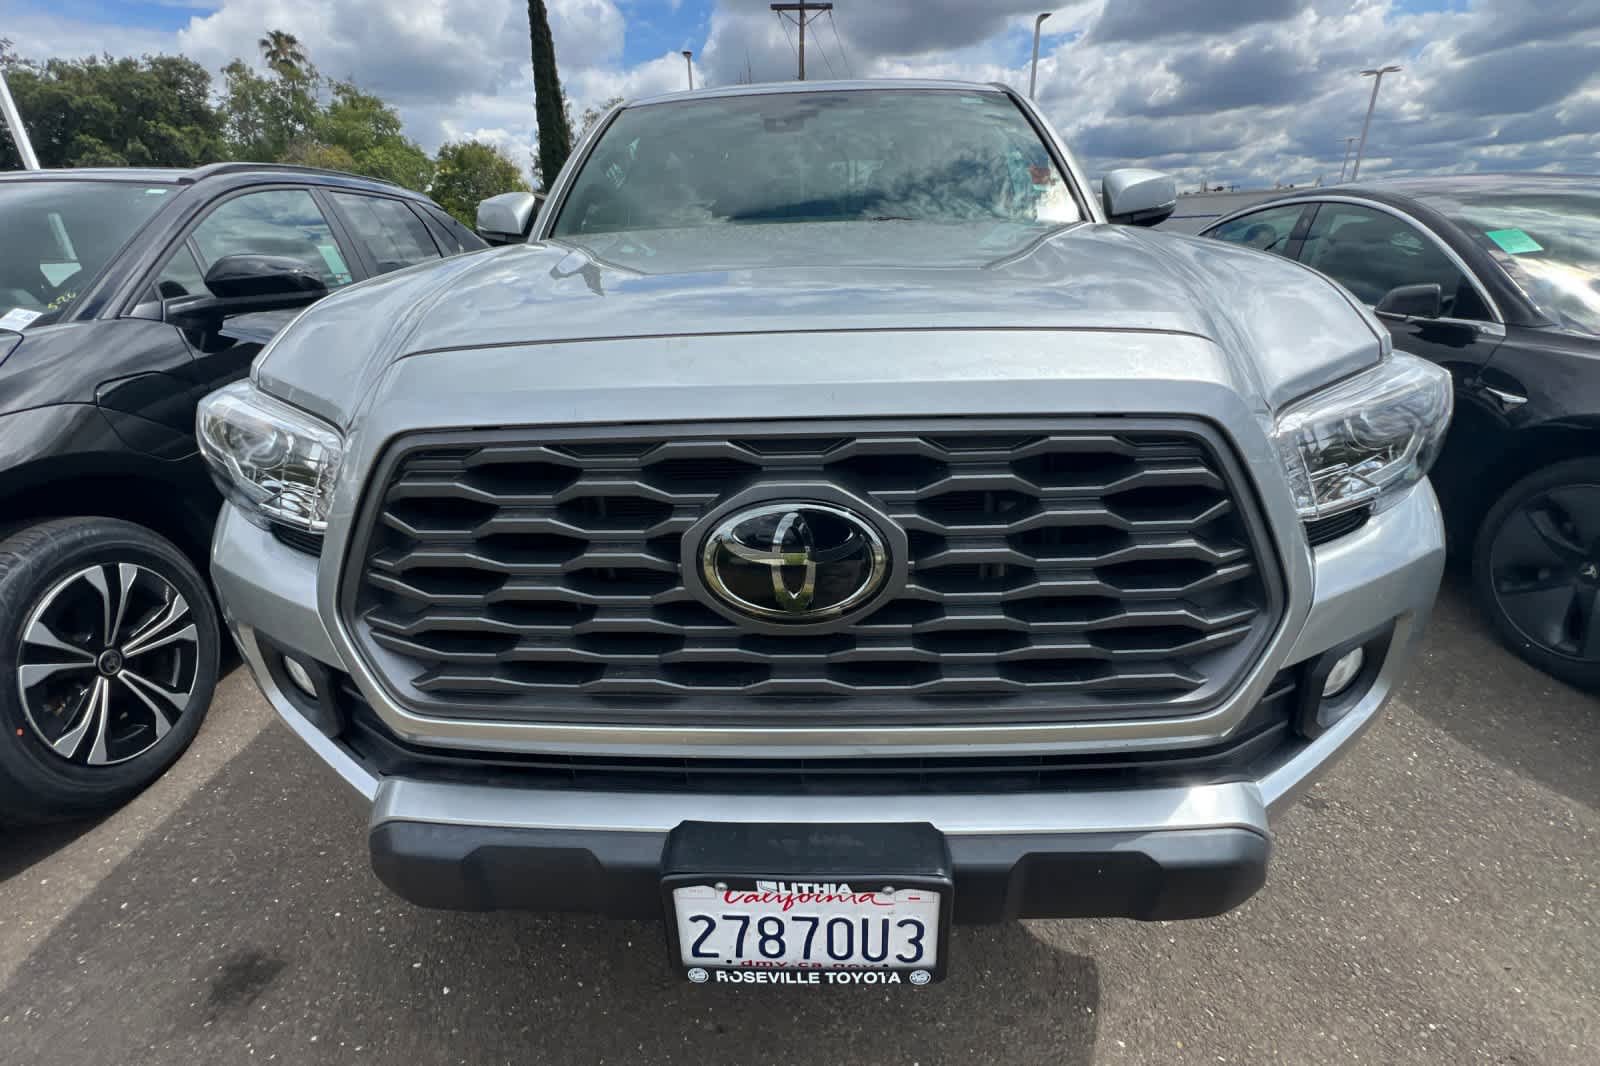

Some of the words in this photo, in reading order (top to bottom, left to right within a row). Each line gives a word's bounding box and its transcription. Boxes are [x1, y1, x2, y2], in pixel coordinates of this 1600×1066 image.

[778, 881, 853, 895] LITHIA
[688, 914, 926, 963] 27870U3
[716, 970, 820, 984] ROSEVILLE
[825, 971, 901, 985] TOYOTA
